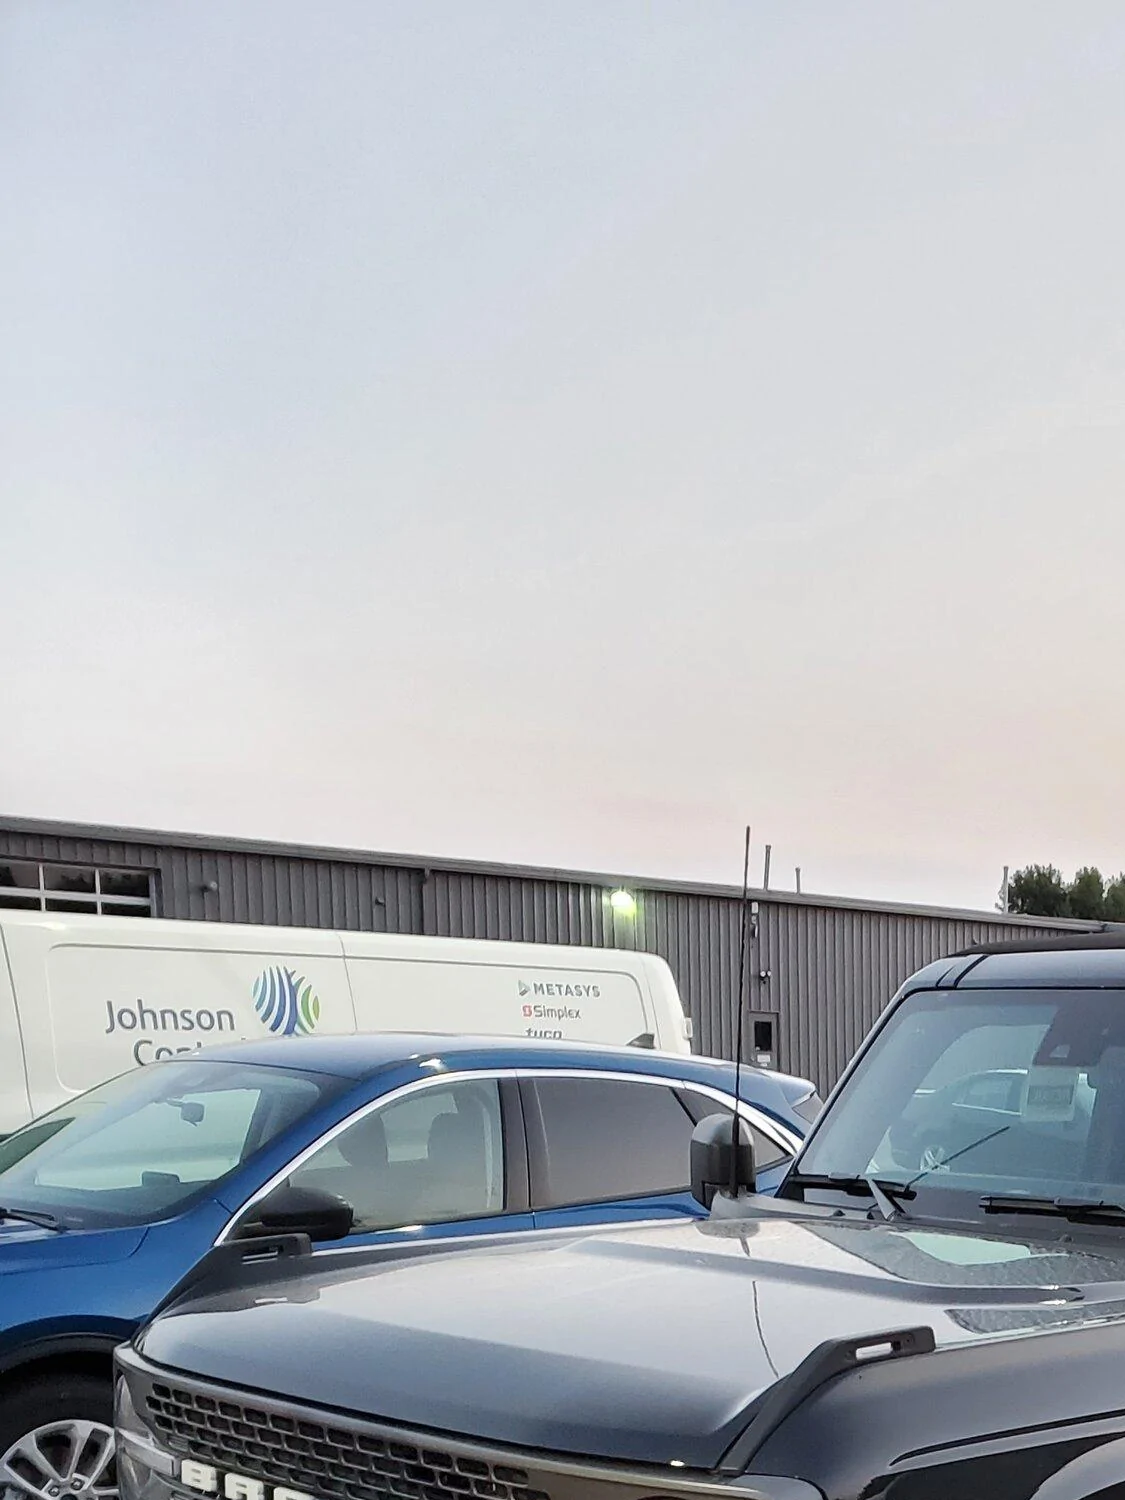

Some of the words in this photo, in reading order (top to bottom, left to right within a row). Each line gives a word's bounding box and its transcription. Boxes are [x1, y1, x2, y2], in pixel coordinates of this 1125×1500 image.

[533, 983, 600, 997] METASYS
[105, 998, 235, 1034] Johnson
[533, 1004, 581, 1020] Simplex
